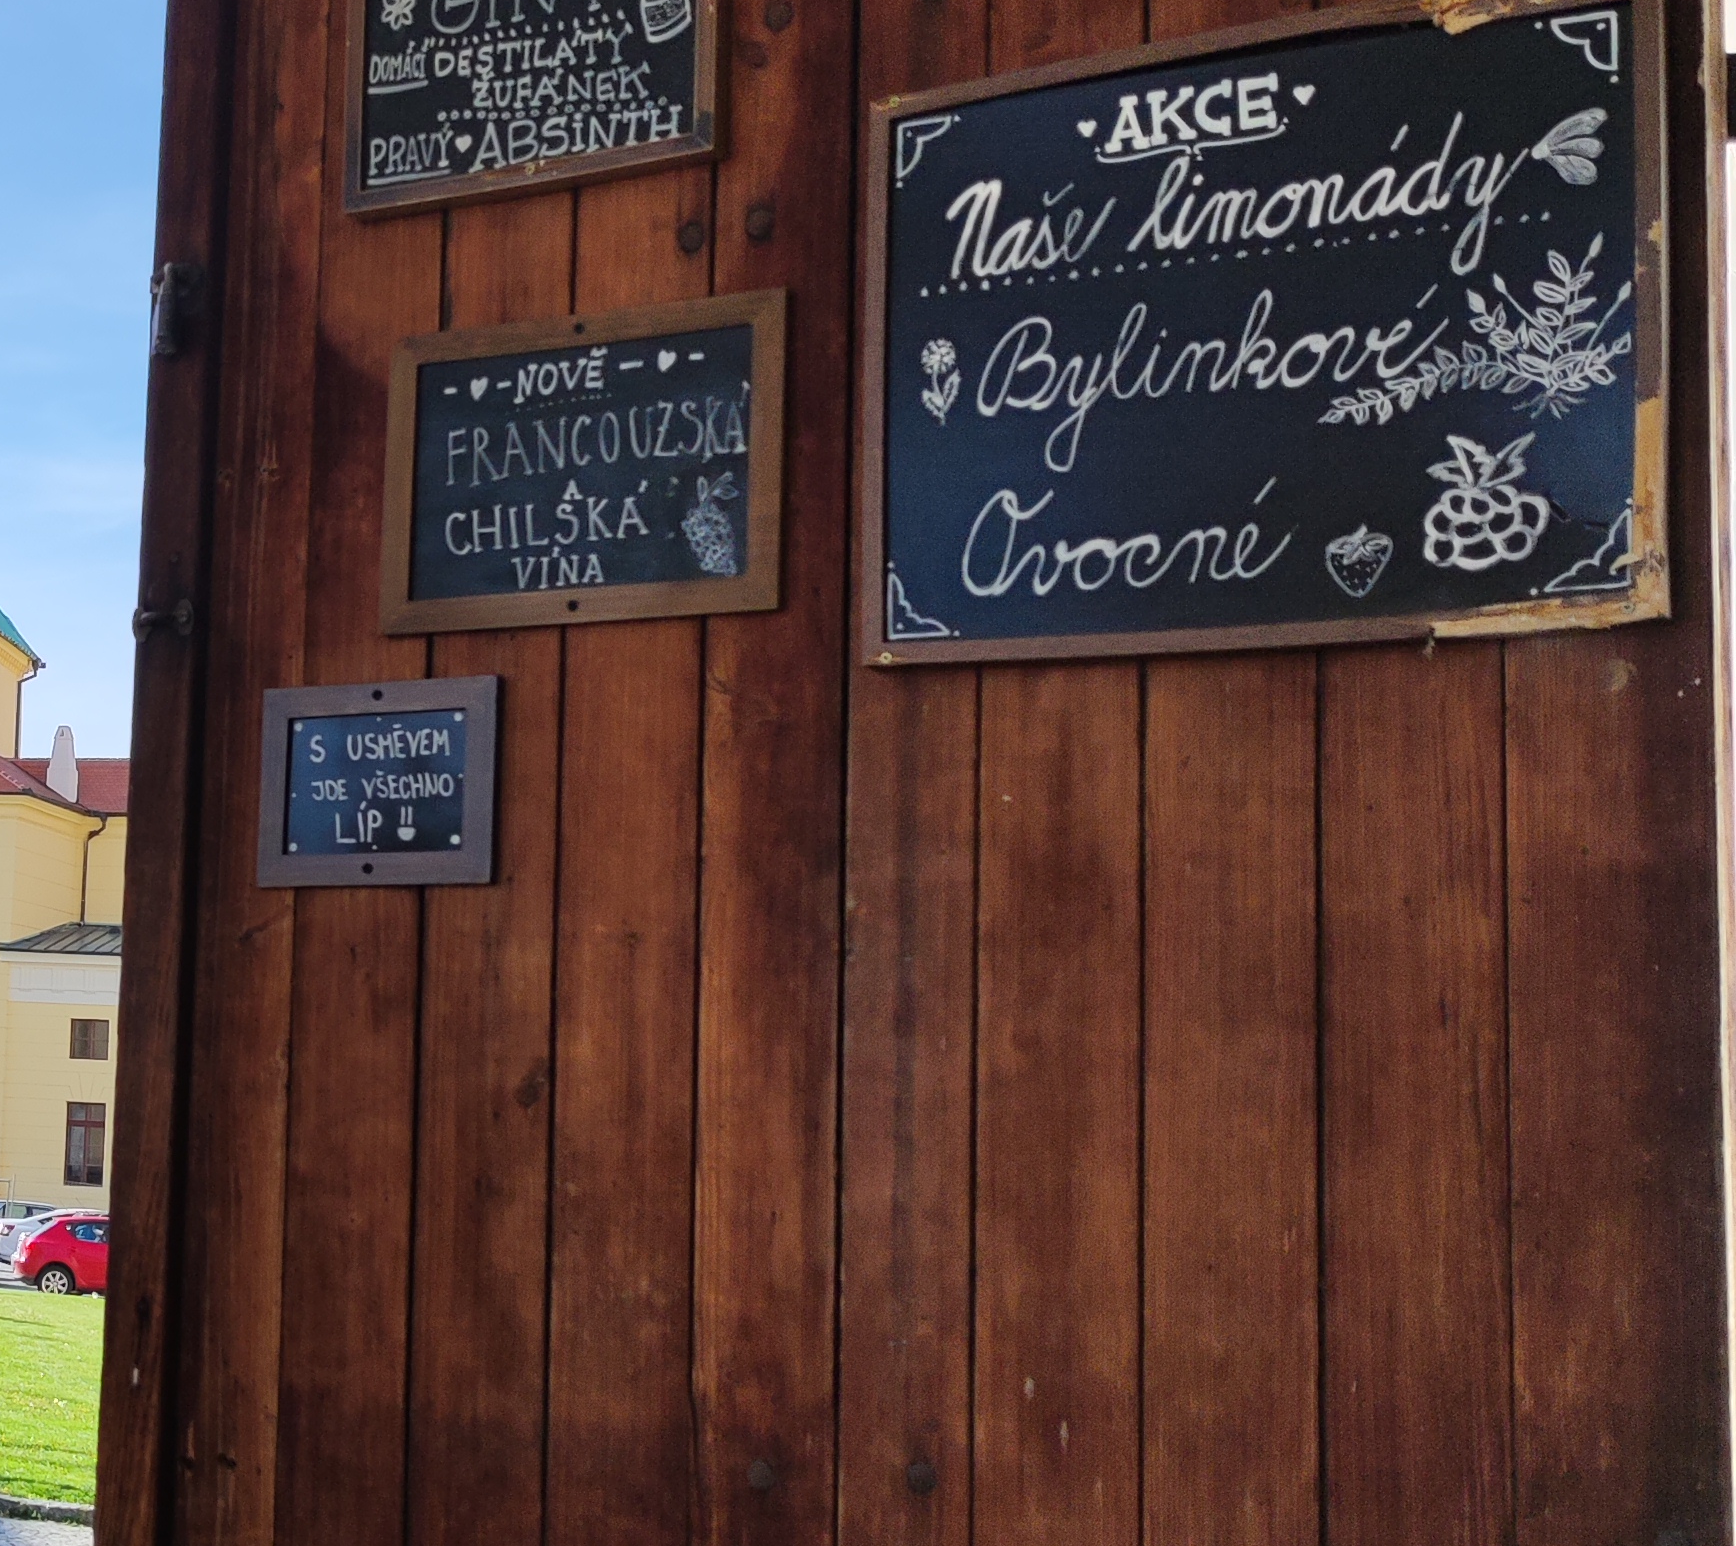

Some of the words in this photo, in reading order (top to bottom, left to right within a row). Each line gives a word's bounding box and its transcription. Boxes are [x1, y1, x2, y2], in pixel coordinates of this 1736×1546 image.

[367, 120, 455, 177] PRAVÝ
[467, 103, 683, 175] ABSINTH
[1102, 72, 1281, 156] AKCE
[944, 178, 1117, 280] Naše
[1127, 111, 1529, 276] limonády
[976, 283, 1450, 473] Bylinkové
[445, 379, 751, 488] FRANCOUZSKÁ
[444, 480, 650, 555] CHILSKÁ
[564, 479, 584, 500] A
[961, 476, 1293, 597] Ovocné
[309, 734, 326, 763] S
[310, 778, 349, 801] JDE
[361, 769, 455, 800] VŠECHNO
[335, 800, 384, 844] LÍP
